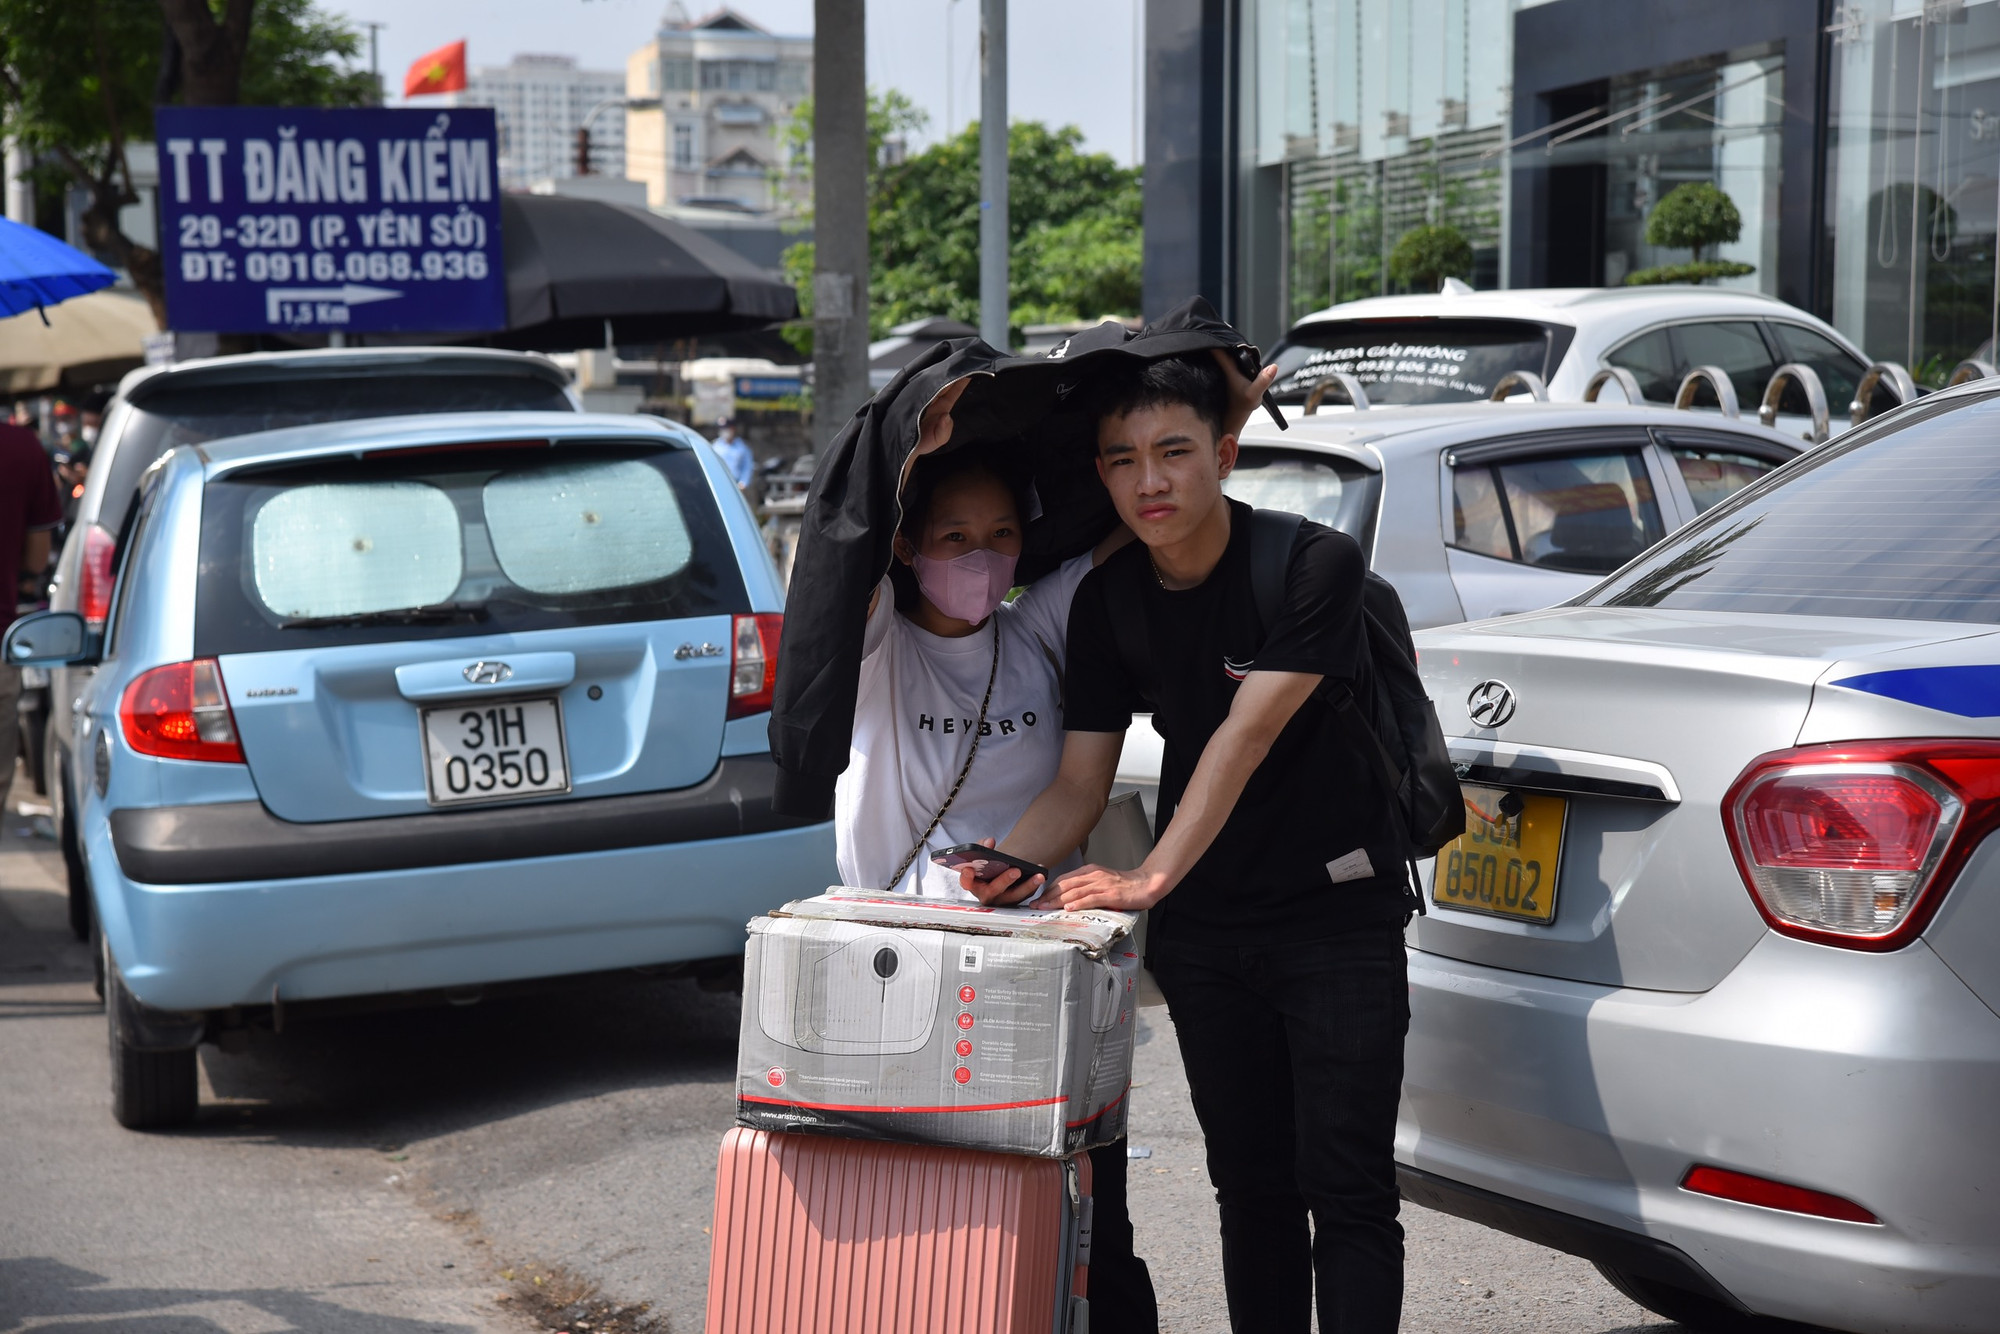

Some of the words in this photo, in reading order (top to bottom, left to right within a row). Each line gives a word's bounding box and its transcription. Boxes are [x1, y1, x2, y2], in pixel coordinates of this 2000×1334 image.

[243, 126, 368, 203] ĐĂNG
[378, 113, 492, 203] KIỂM
[179, 214, 301, 248] 29-32D
[310, 215, 350, 250] (P.
[357, 208, 422, 246] YÊN
[430, 203, 487, 249] SỞ)
[181, 252, 235, 281] ĐT:
[245, 251, 488, 281] 0916.068.936
[281, 303, 312, 324] 1,5
[316, 304, 350, 323] Km
[1305, 347, 1365, 365] MAZDA
[1356, 360, 1395, 373] 0938
[1427, 362, 1460, 377] 359
[460, 706, 526, 749] 31H
[446, 748, 549, 794] 0350
[1446, 850, 1542, 911] 850.02
[760, 1112, 818, 1123] www.ariston.com
